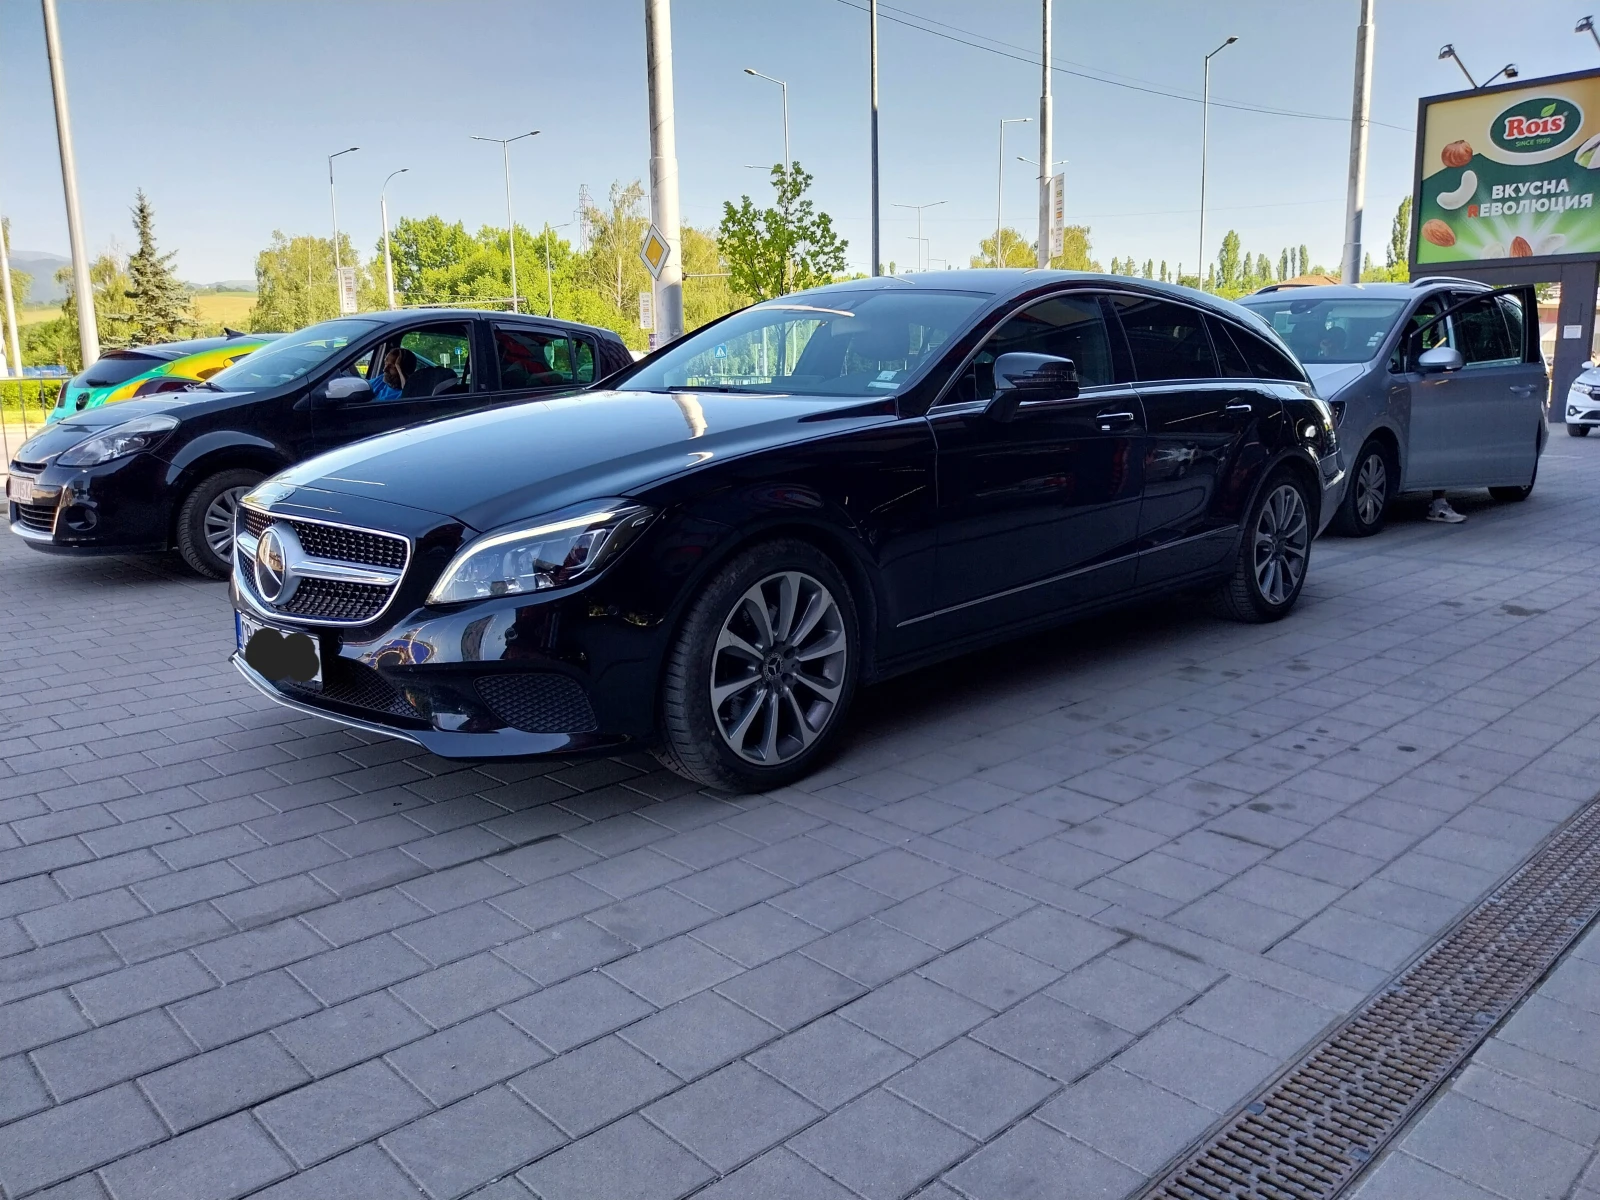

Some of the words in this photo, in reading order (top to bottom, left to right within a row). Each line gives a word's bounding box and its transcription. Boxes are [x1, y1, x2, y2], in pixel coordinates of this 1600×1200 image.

[1505, 117, 1563, 138] Rois
[1515, 139, 1534, 147] SINCE
[1536, 137, 1551, 145] 1999
[1491, 178, 1570, 200] ВКУСНА
